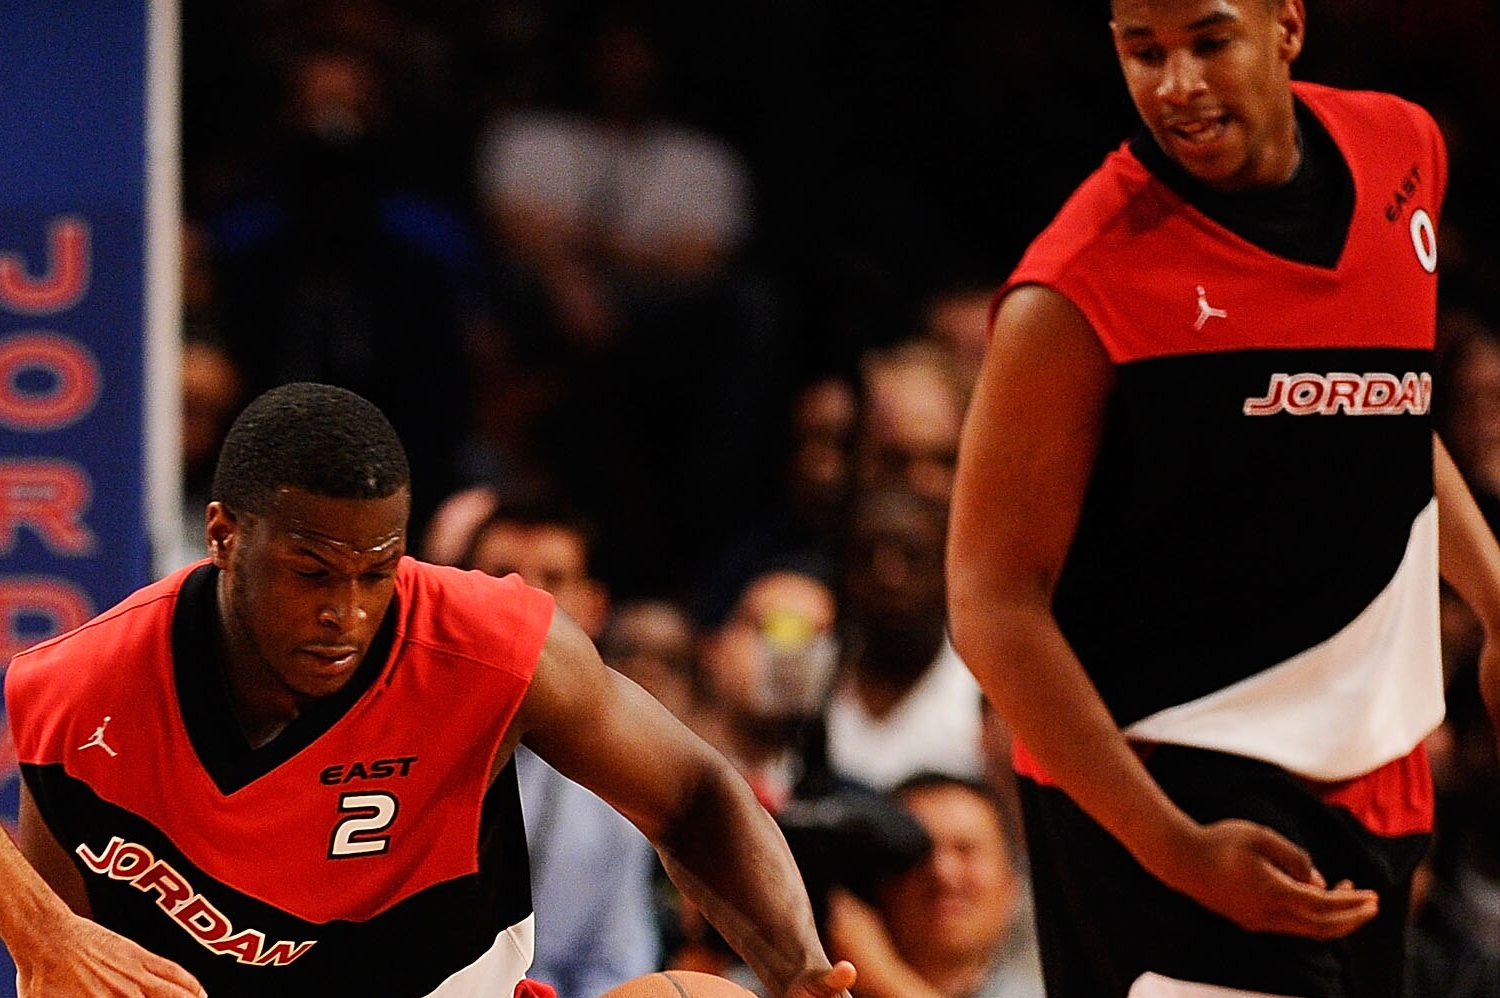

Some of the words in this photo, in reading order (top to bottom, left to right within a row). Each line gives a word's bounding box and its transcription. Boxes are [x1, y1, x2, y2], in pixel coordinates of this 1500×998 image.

[1385, 166, 1421, 222] EAST
[1409, 208, 1438, 273] 0
[319, 757, 418, 785] EAST
[327, 790, 400, 860] 2
[76, 836, 318, 967] JORDAN
